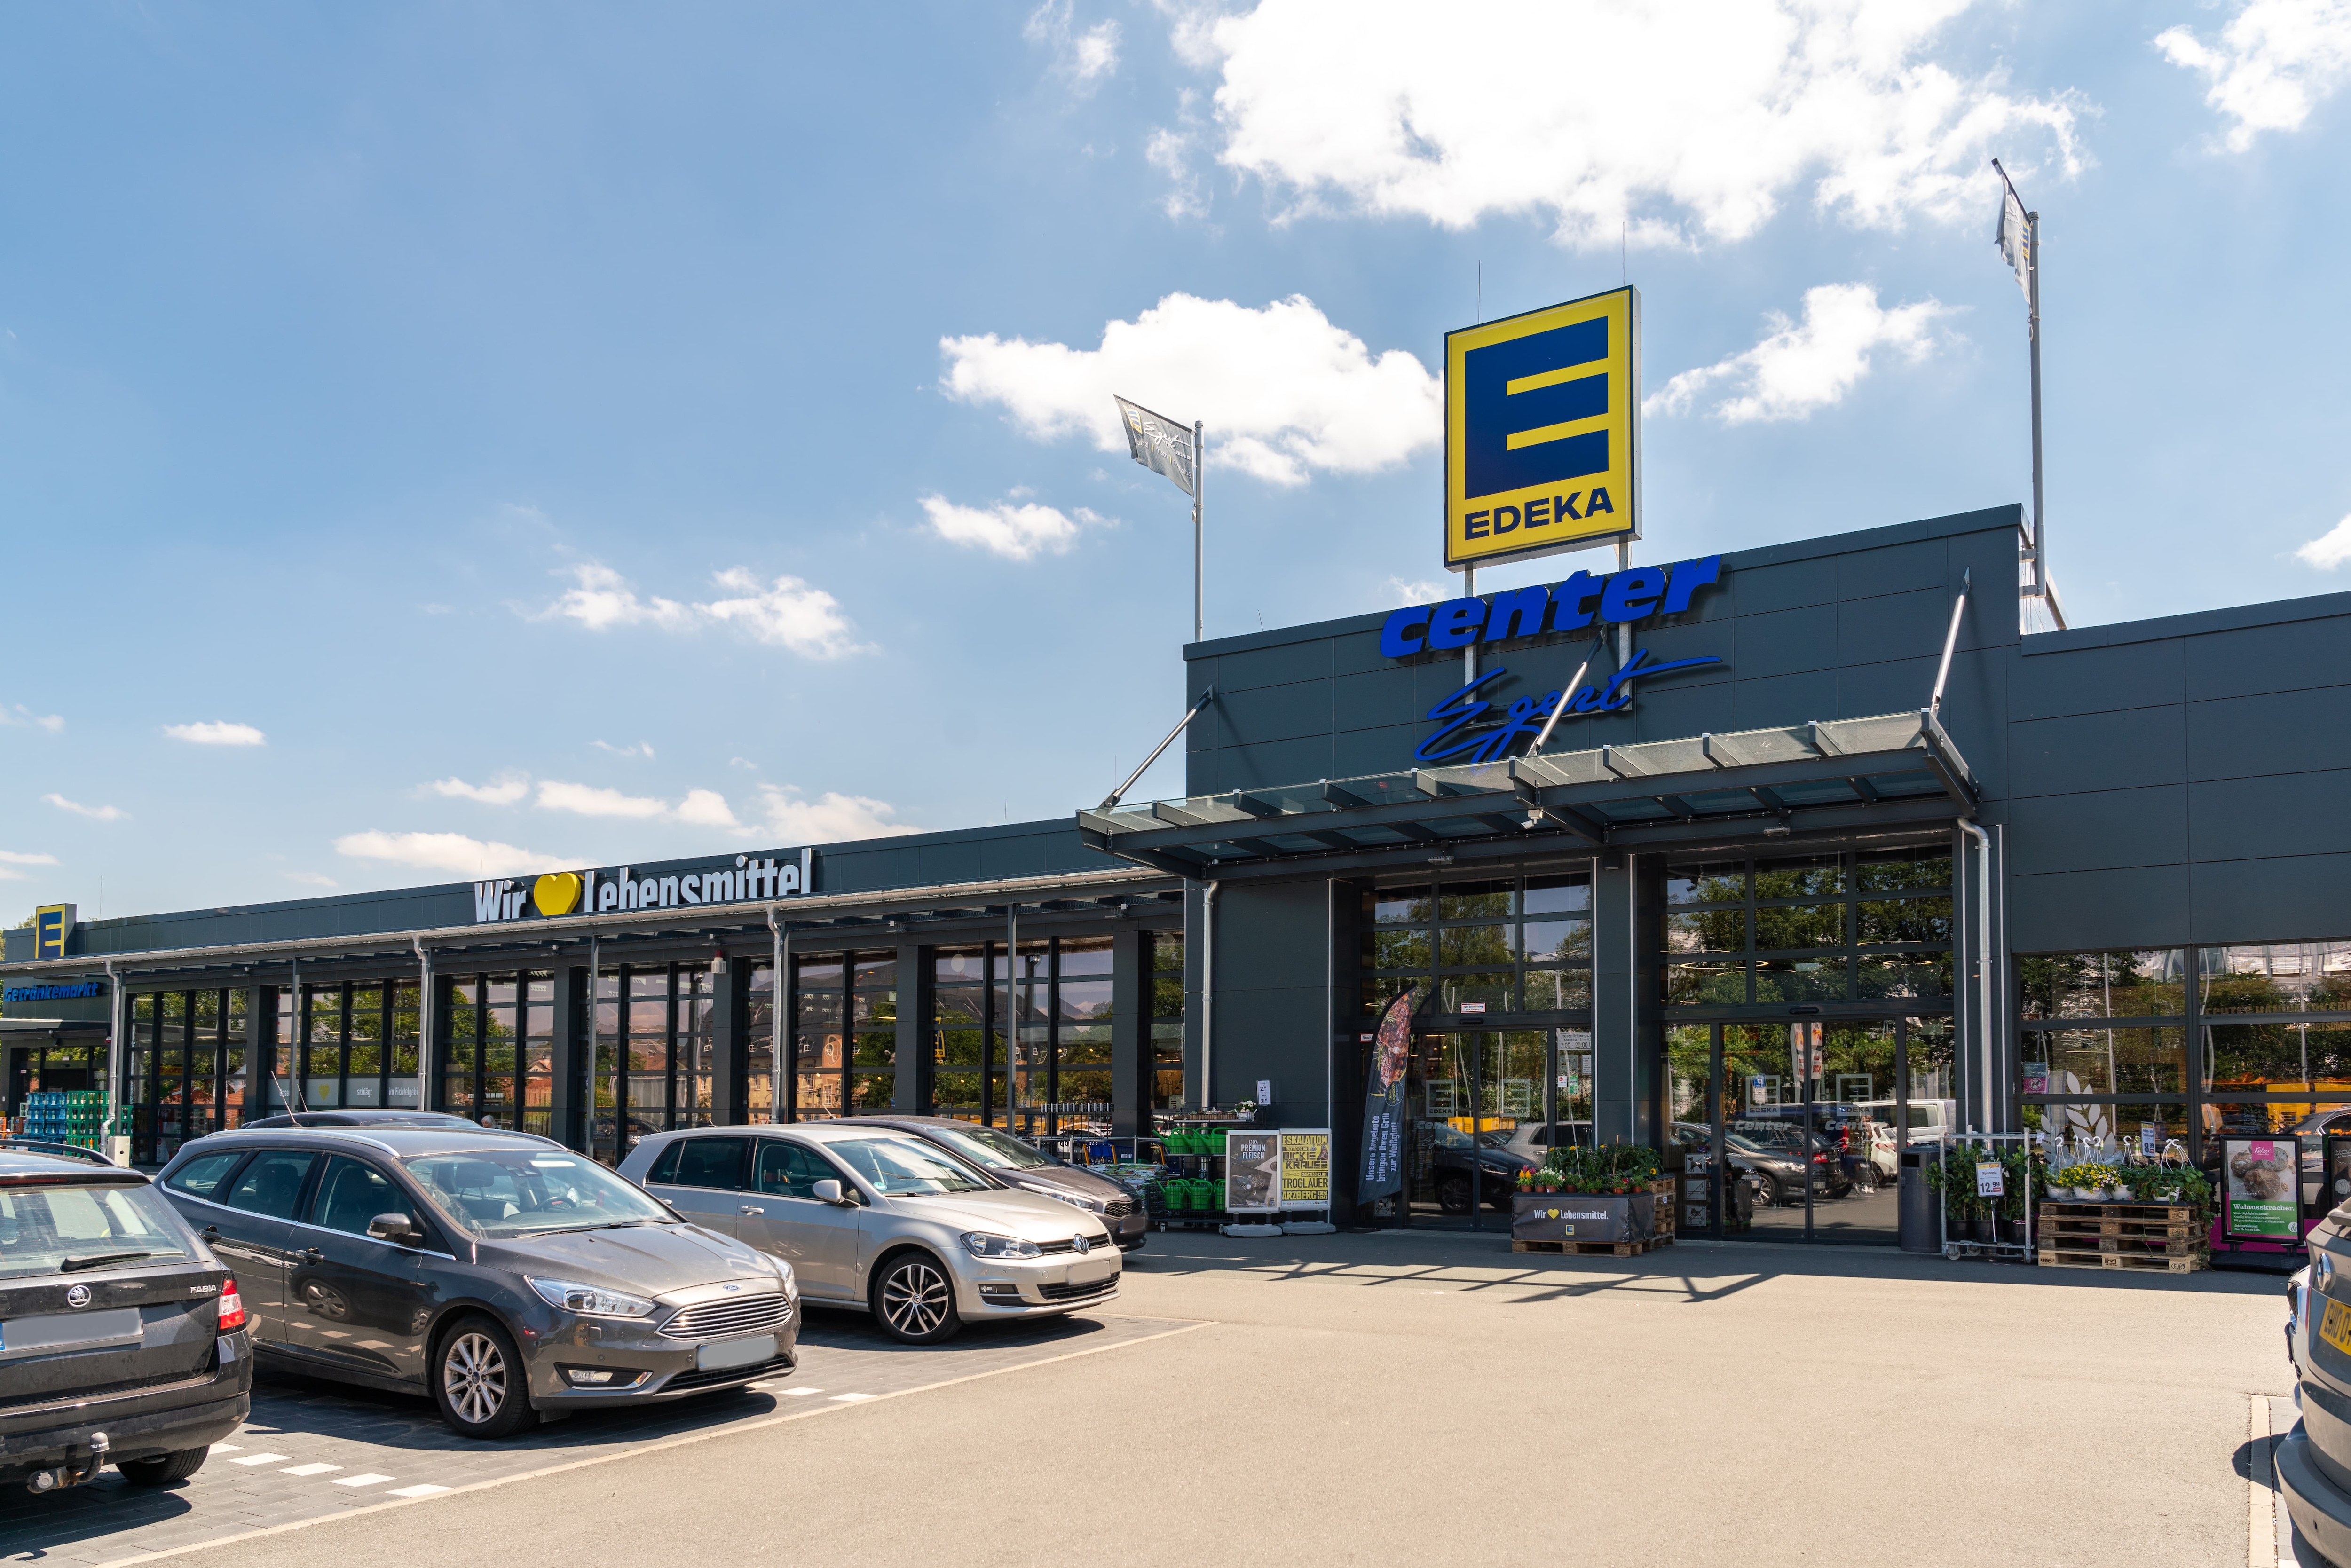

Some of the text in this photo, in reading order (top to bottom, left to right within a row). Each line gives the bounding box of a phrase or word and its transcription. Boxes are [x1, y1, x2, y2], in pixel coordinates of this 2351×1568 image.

[1465, 315, 1609, 500] E
[1465, 487, 1614, 540] EDEKA
[1380, 554, 1722, 658] center
[1414, 648, 1723, 767] Egert
[474, 880, 526, 922] Wir
[4, 982, 98, 1002] Getränkemarkt
[357, 1087, 372, 1098] schlägt
[389, 1087, 394, 1096] im
[395, 1087, 418, 1097] Fichtelgebi
[1735, 1120, 1792, 1130] center
[1282, 1135, 1327, 1144] ESKALATION
[1366, 1115, 1380, 1180] Unsere Angebote
[1376, 1113, 1389, 1182] bringen Ihren Grill
[1389, 1122, 1400, 1158] Weißglut!
[1286, 1161, 1327, 1169] KRAUSE
[1282, 1178, 1328, 1188] TROGLAUER
[1282, 1191, 1317, 1200] ARZBERG
[1534, 1210, 1609, 1220] Wir Lebensmittel.
[190, 1285, 216, 1294] FABIA
